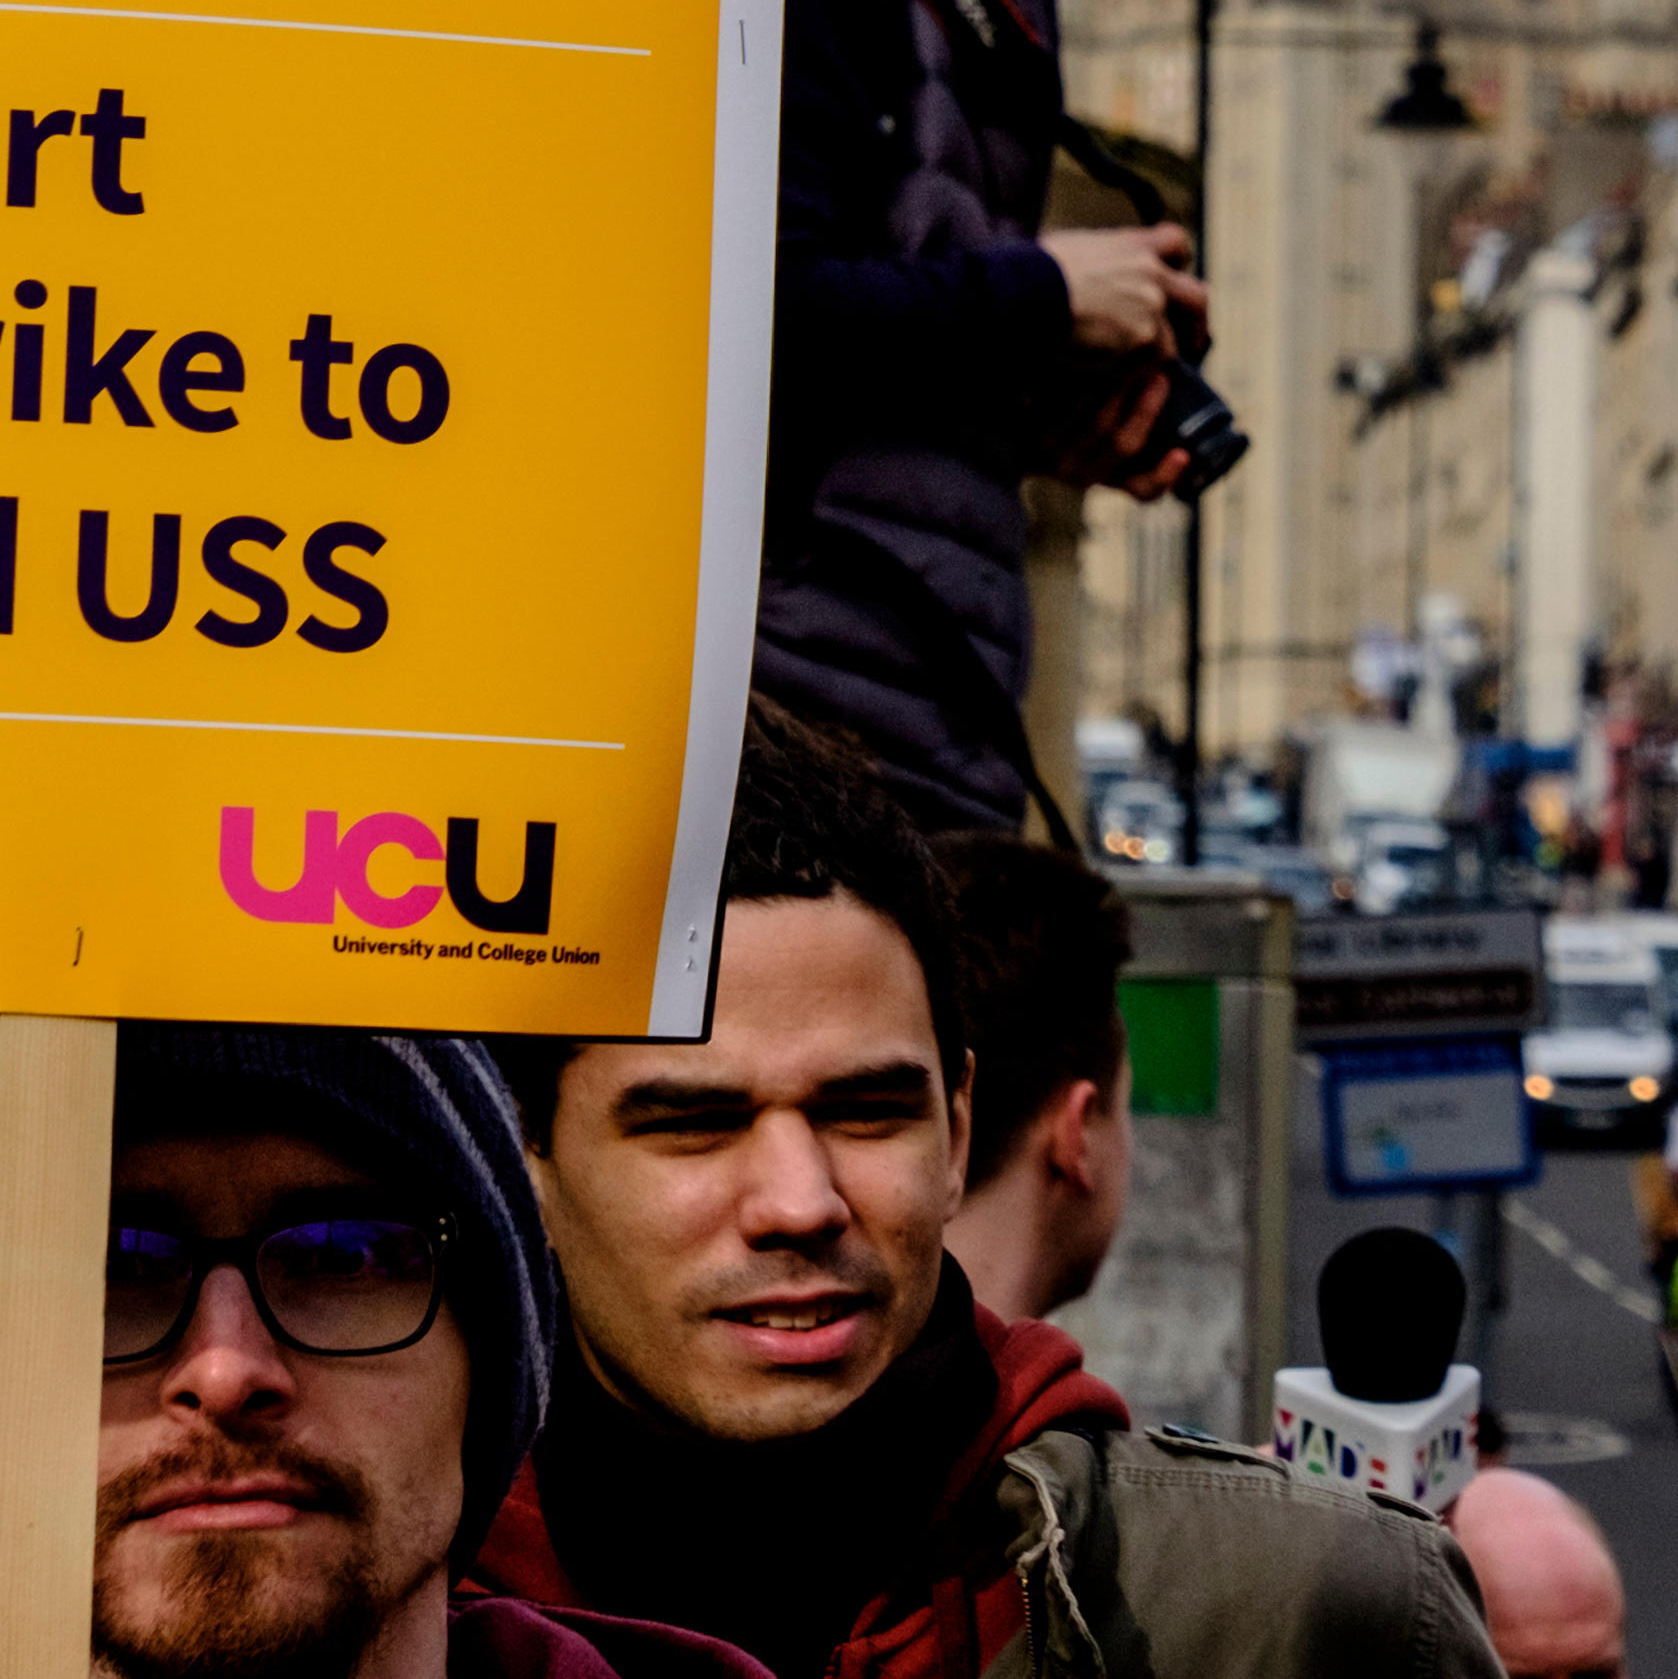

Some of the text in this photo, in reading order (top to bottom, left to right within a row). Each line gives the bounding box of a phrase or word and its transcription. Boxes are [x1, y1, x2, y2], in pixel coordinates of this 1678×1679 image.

[288, 313, 451, 446] to
[76, 509, 390, 654] USS
[332, 935, 601, 966] University and College Union
